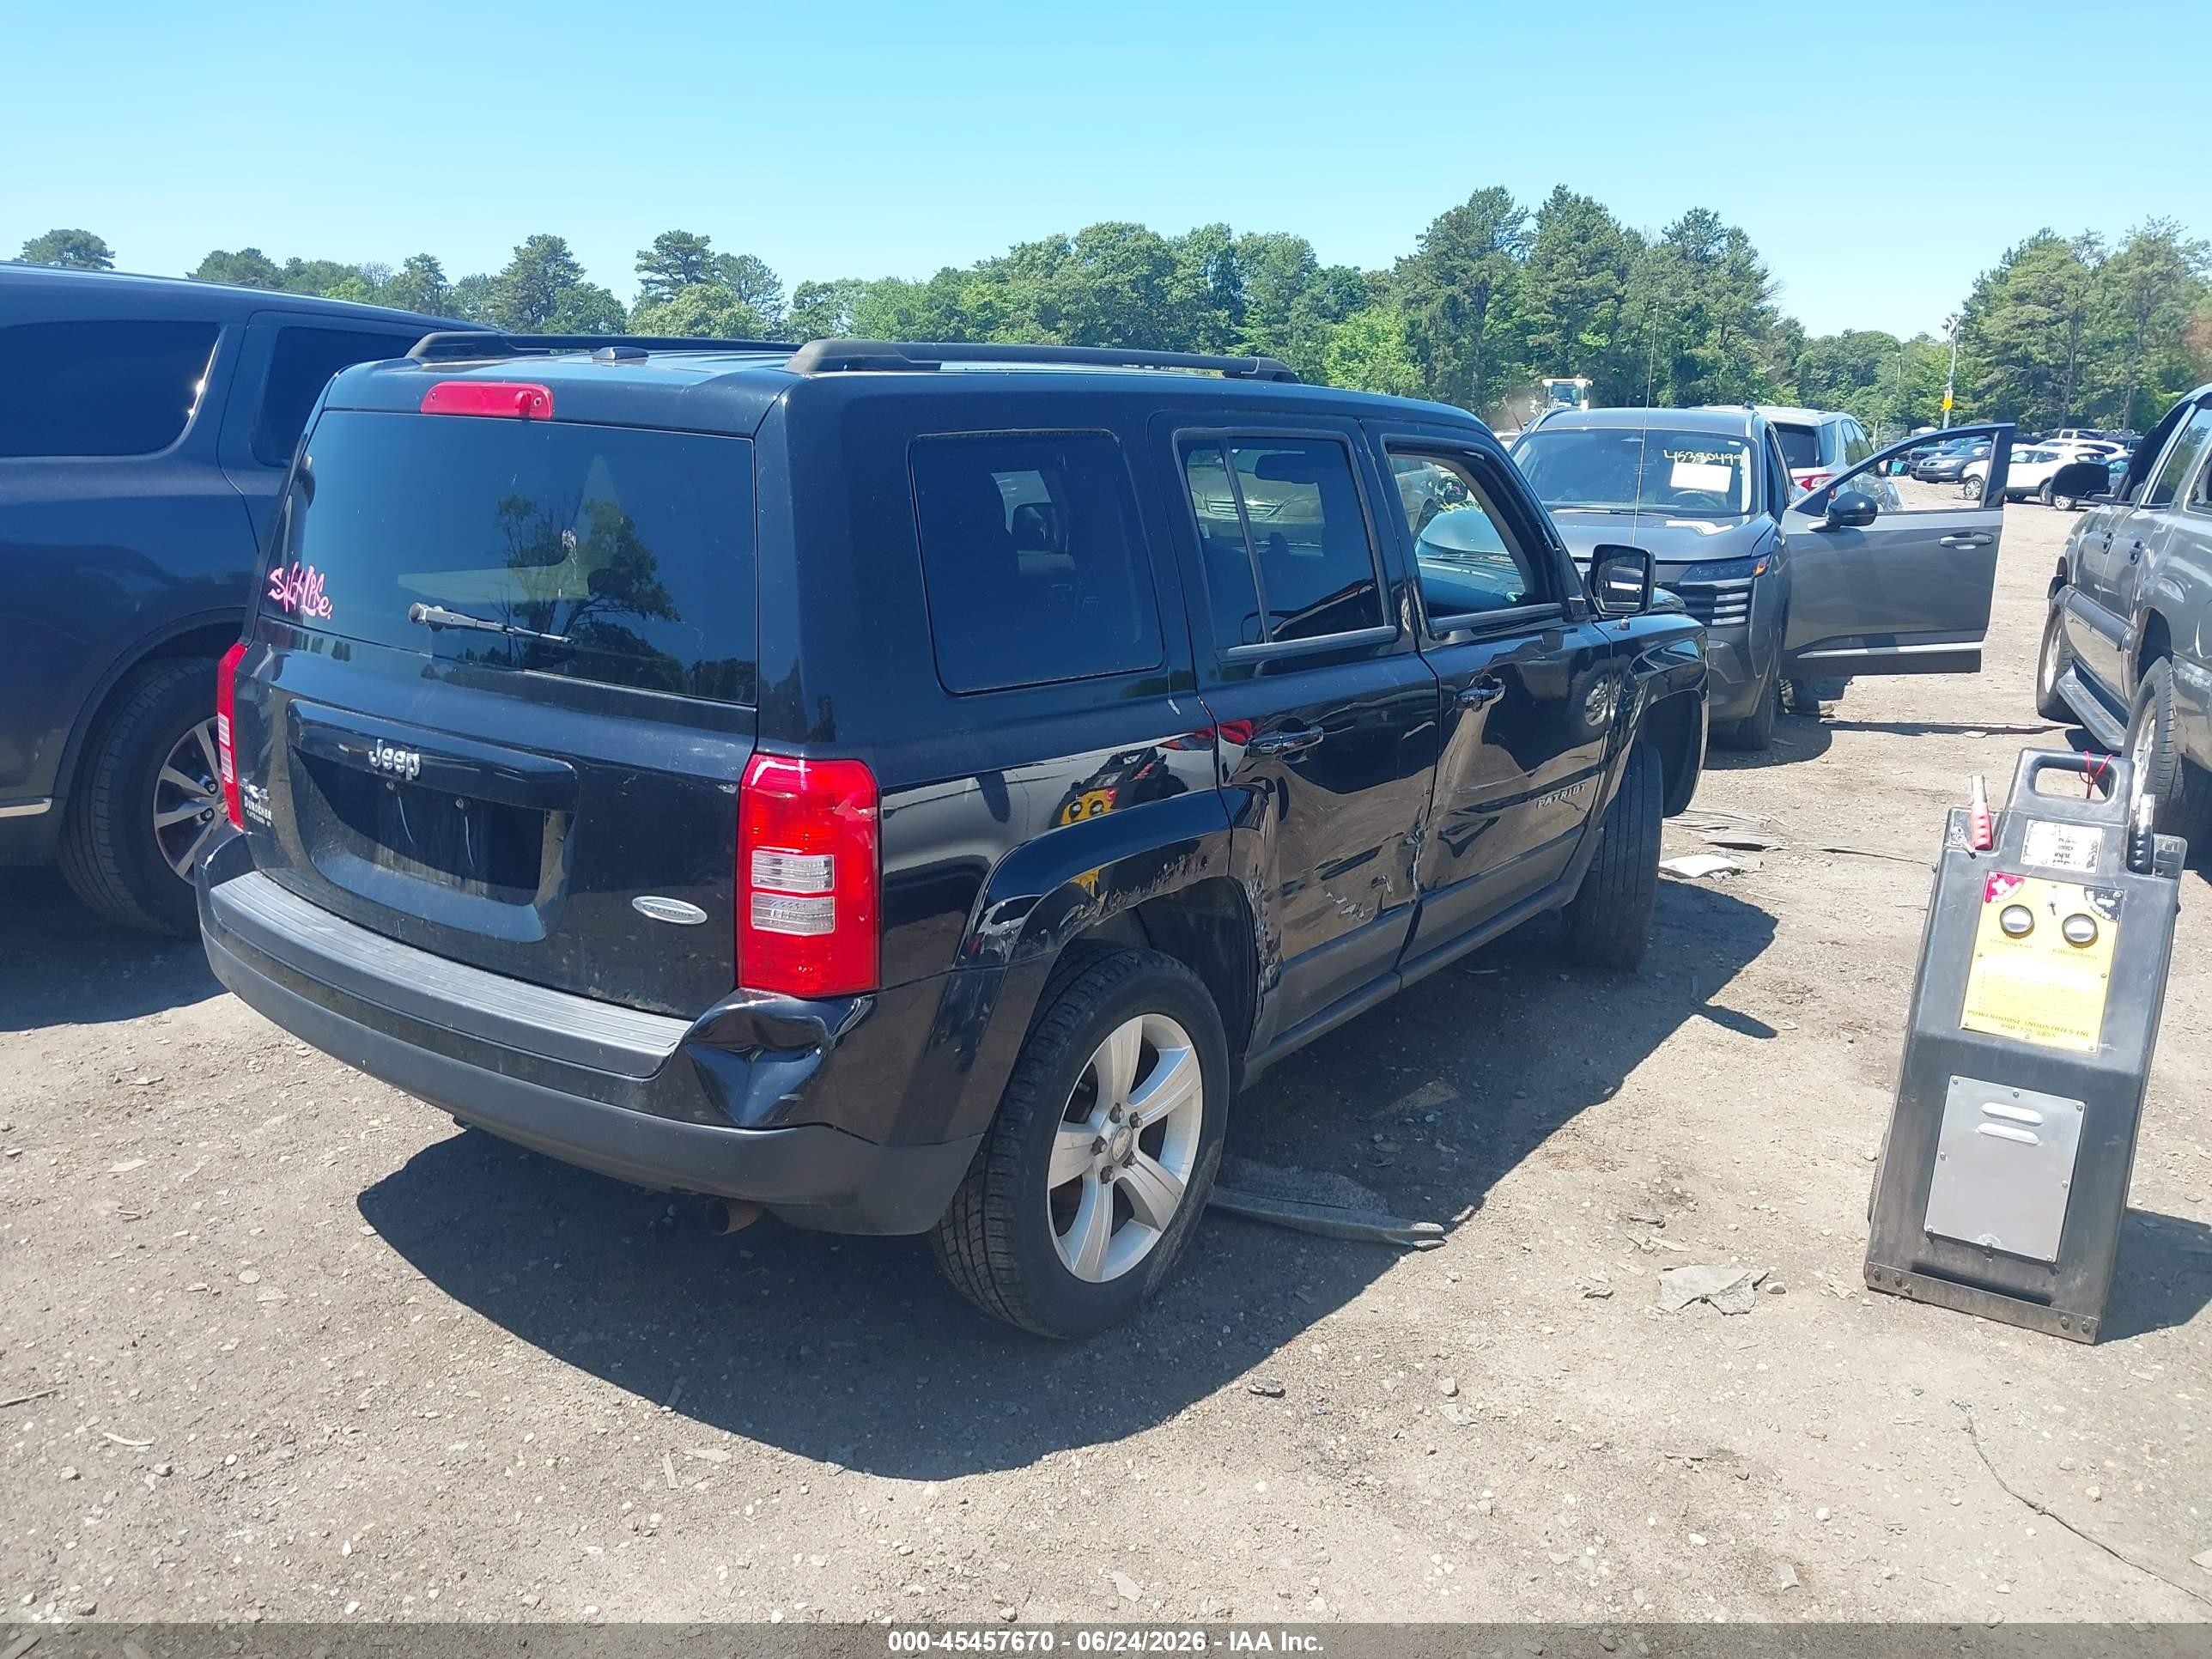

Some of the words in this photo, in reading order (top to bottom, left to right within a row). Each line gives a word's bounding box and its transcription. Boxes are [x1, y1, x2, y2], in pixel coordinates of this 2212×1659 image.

[368, 738, 421, 781] Jeep
[1536, 782, 1587, 809] PATRIOT
[2025, 1021, 2074, 1035] INDUSTRIES
